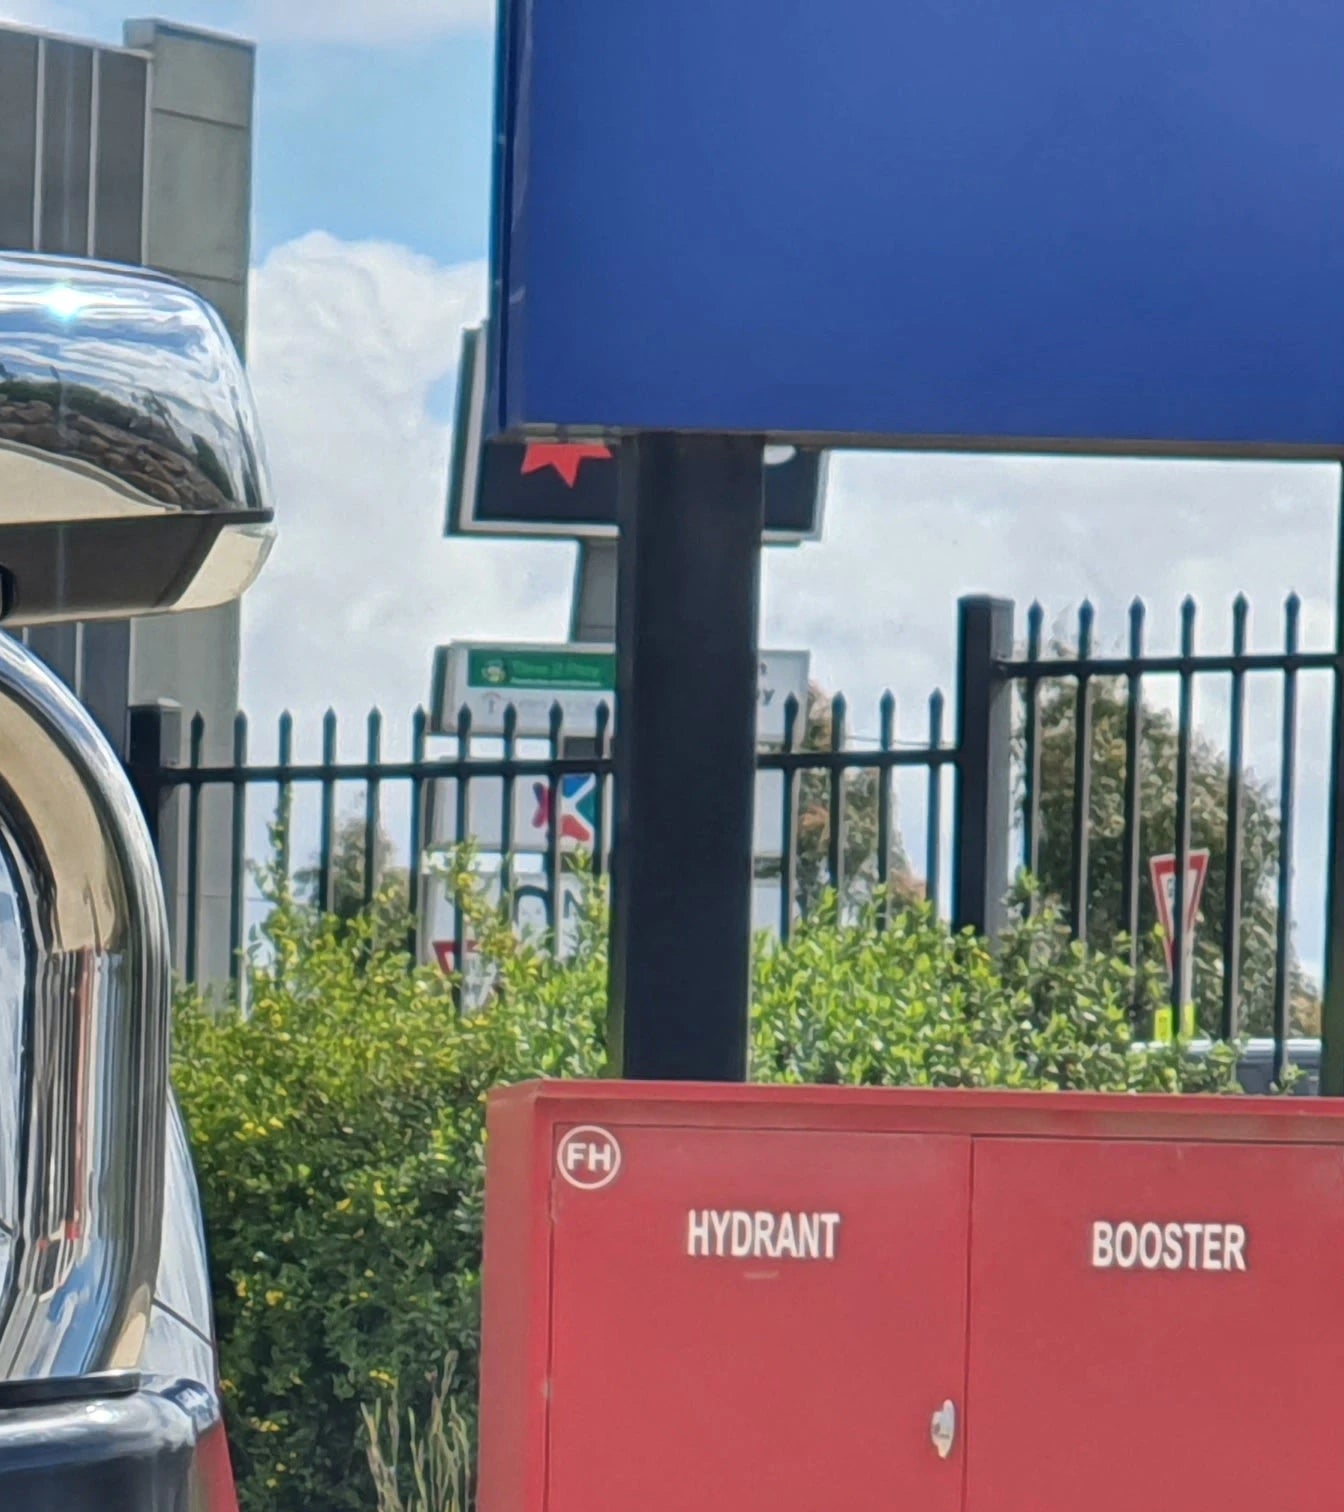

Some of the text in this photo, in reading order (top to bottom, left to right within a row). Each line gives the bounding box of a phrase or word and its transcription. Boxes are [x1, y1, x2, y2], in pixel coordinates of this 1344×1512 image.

[567, 1142, 612, 1172] FH
[687, 1209, 840, 1259] HYDRANT
[1091, 1220, 1247, 1272] BOOSTER
